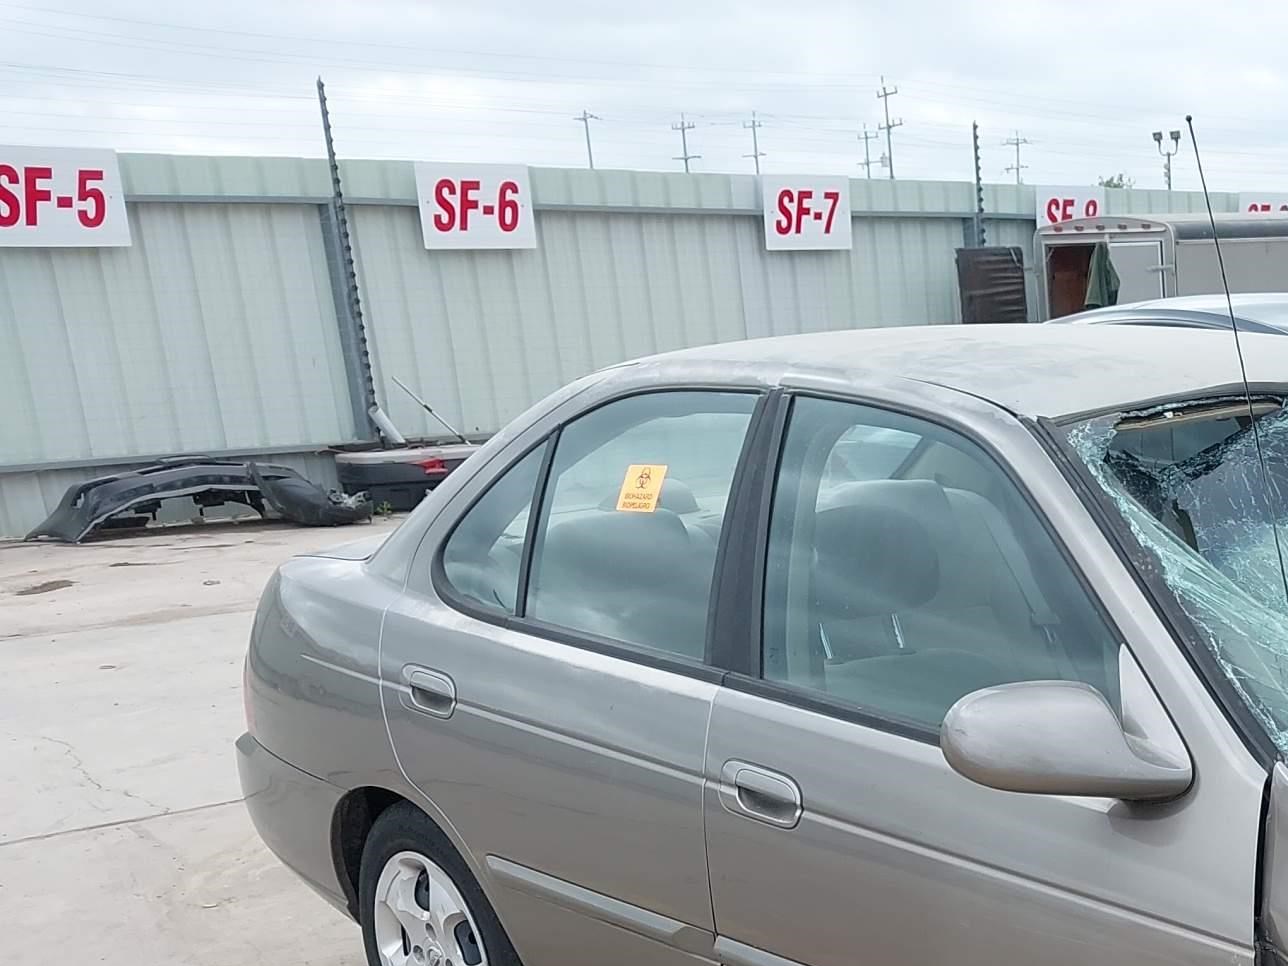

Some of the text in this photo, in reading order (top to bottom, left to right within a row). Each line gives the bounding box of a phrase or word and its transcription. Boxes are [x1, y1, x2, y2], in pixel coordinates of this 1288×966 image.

[0, 163, 106, 230] SF-5
[433, 178, 520, 234] SF-6
[775, 188, 841, 237] SF-7
